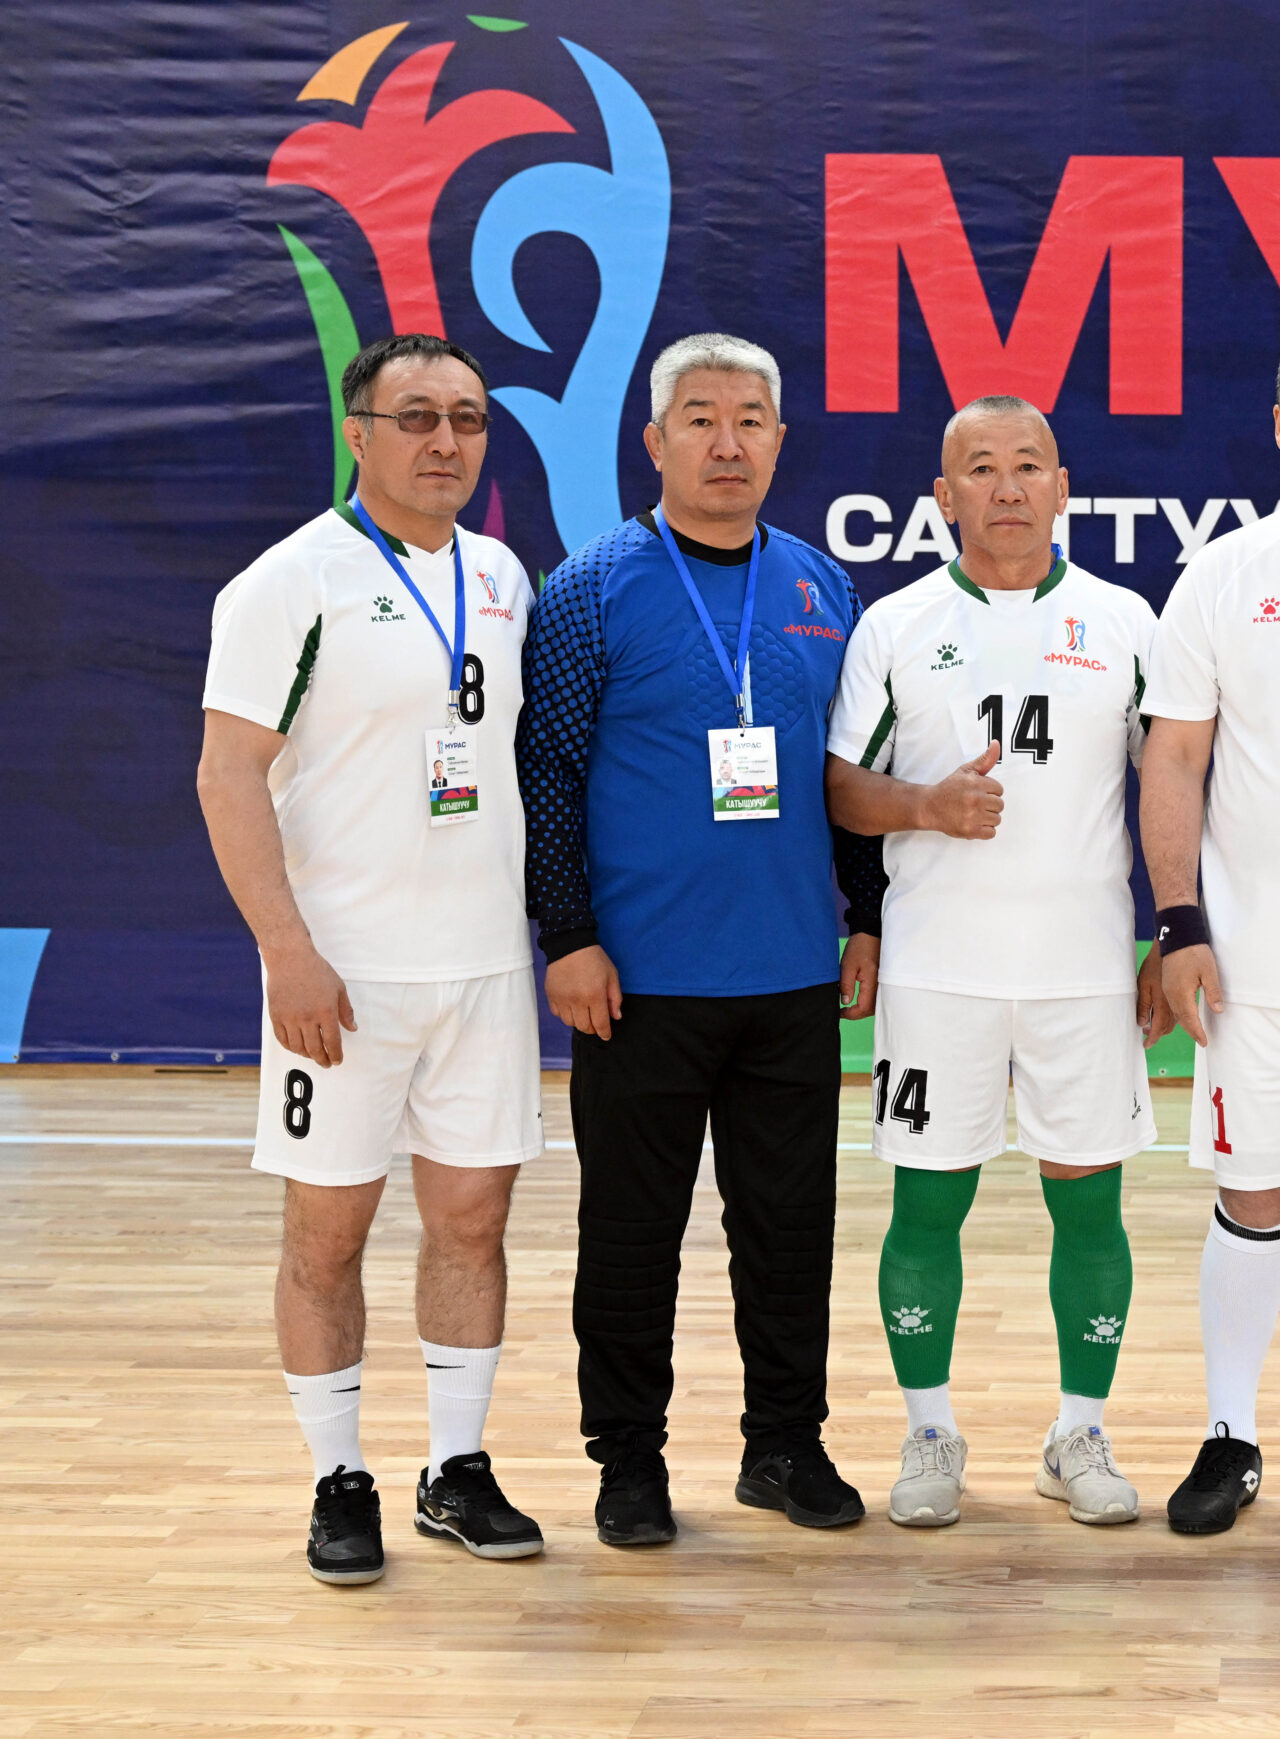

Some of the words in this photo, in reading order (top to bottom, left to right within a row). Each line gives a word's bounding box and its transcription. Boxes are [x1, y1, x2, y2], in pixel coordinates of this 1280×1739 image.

[371, 614, 406, 622] KELME
[931, 659, 964, 671] KELME
[1043, 652, 1107, 671] «МУРАС»
[457, 653, 485, 725] 8
[977, 694, 1054, 764] 14
[283, 1069, 313, 1139] 8
[874, 1059, 930, 1135] 14
[890, 1324, 933, 1335] KELME
